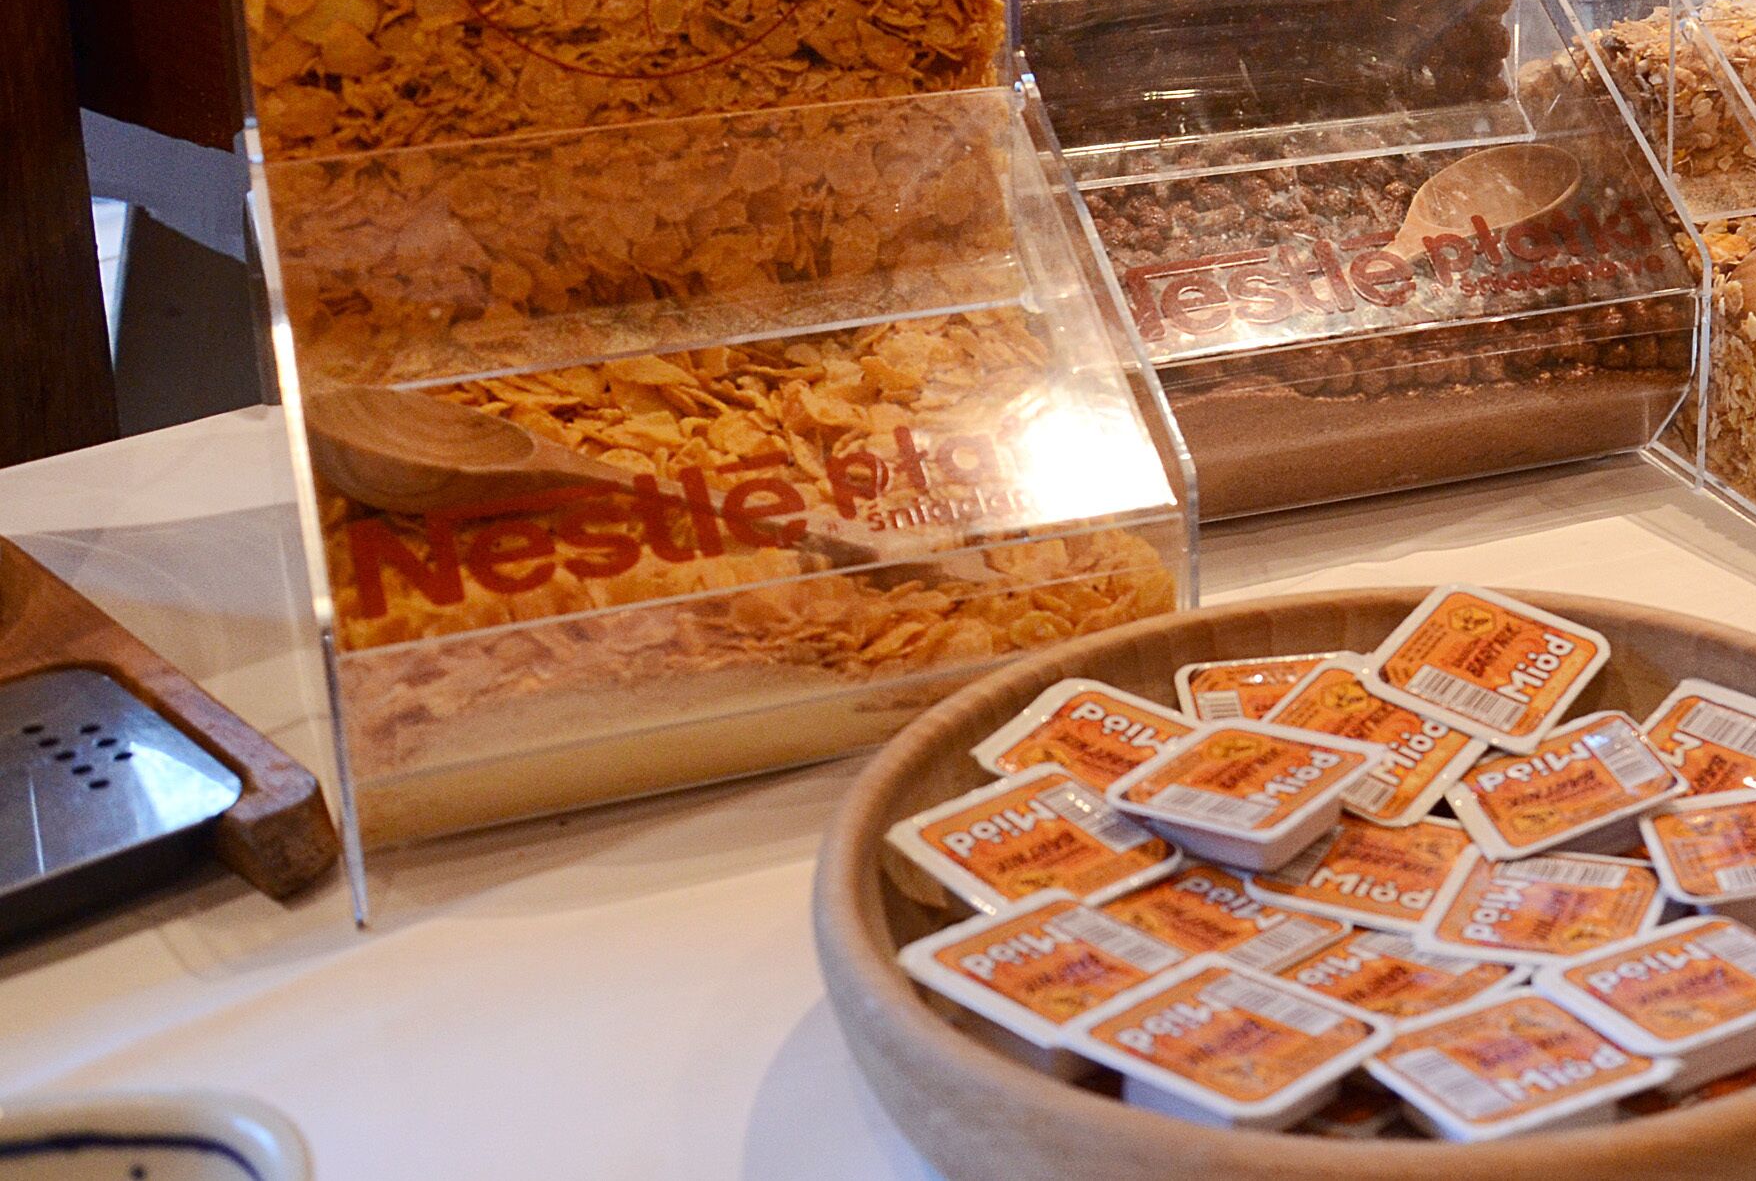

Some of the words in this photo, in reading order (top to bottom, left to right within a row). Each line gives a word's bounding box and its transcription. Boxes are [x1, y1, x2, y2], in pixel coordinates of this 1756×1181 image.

[1496, 631, 1577, 704] Miód
[1247, 749, 1343, 807] Miód
[1476, 741, 1593, 793] Miód
[941, 799, 1060, 859] Miód
[1308, 867, 1435, 910] Miód
[1297, 945, 1384, 987] Mió
[1586, 939, 1714, 995] Miód
